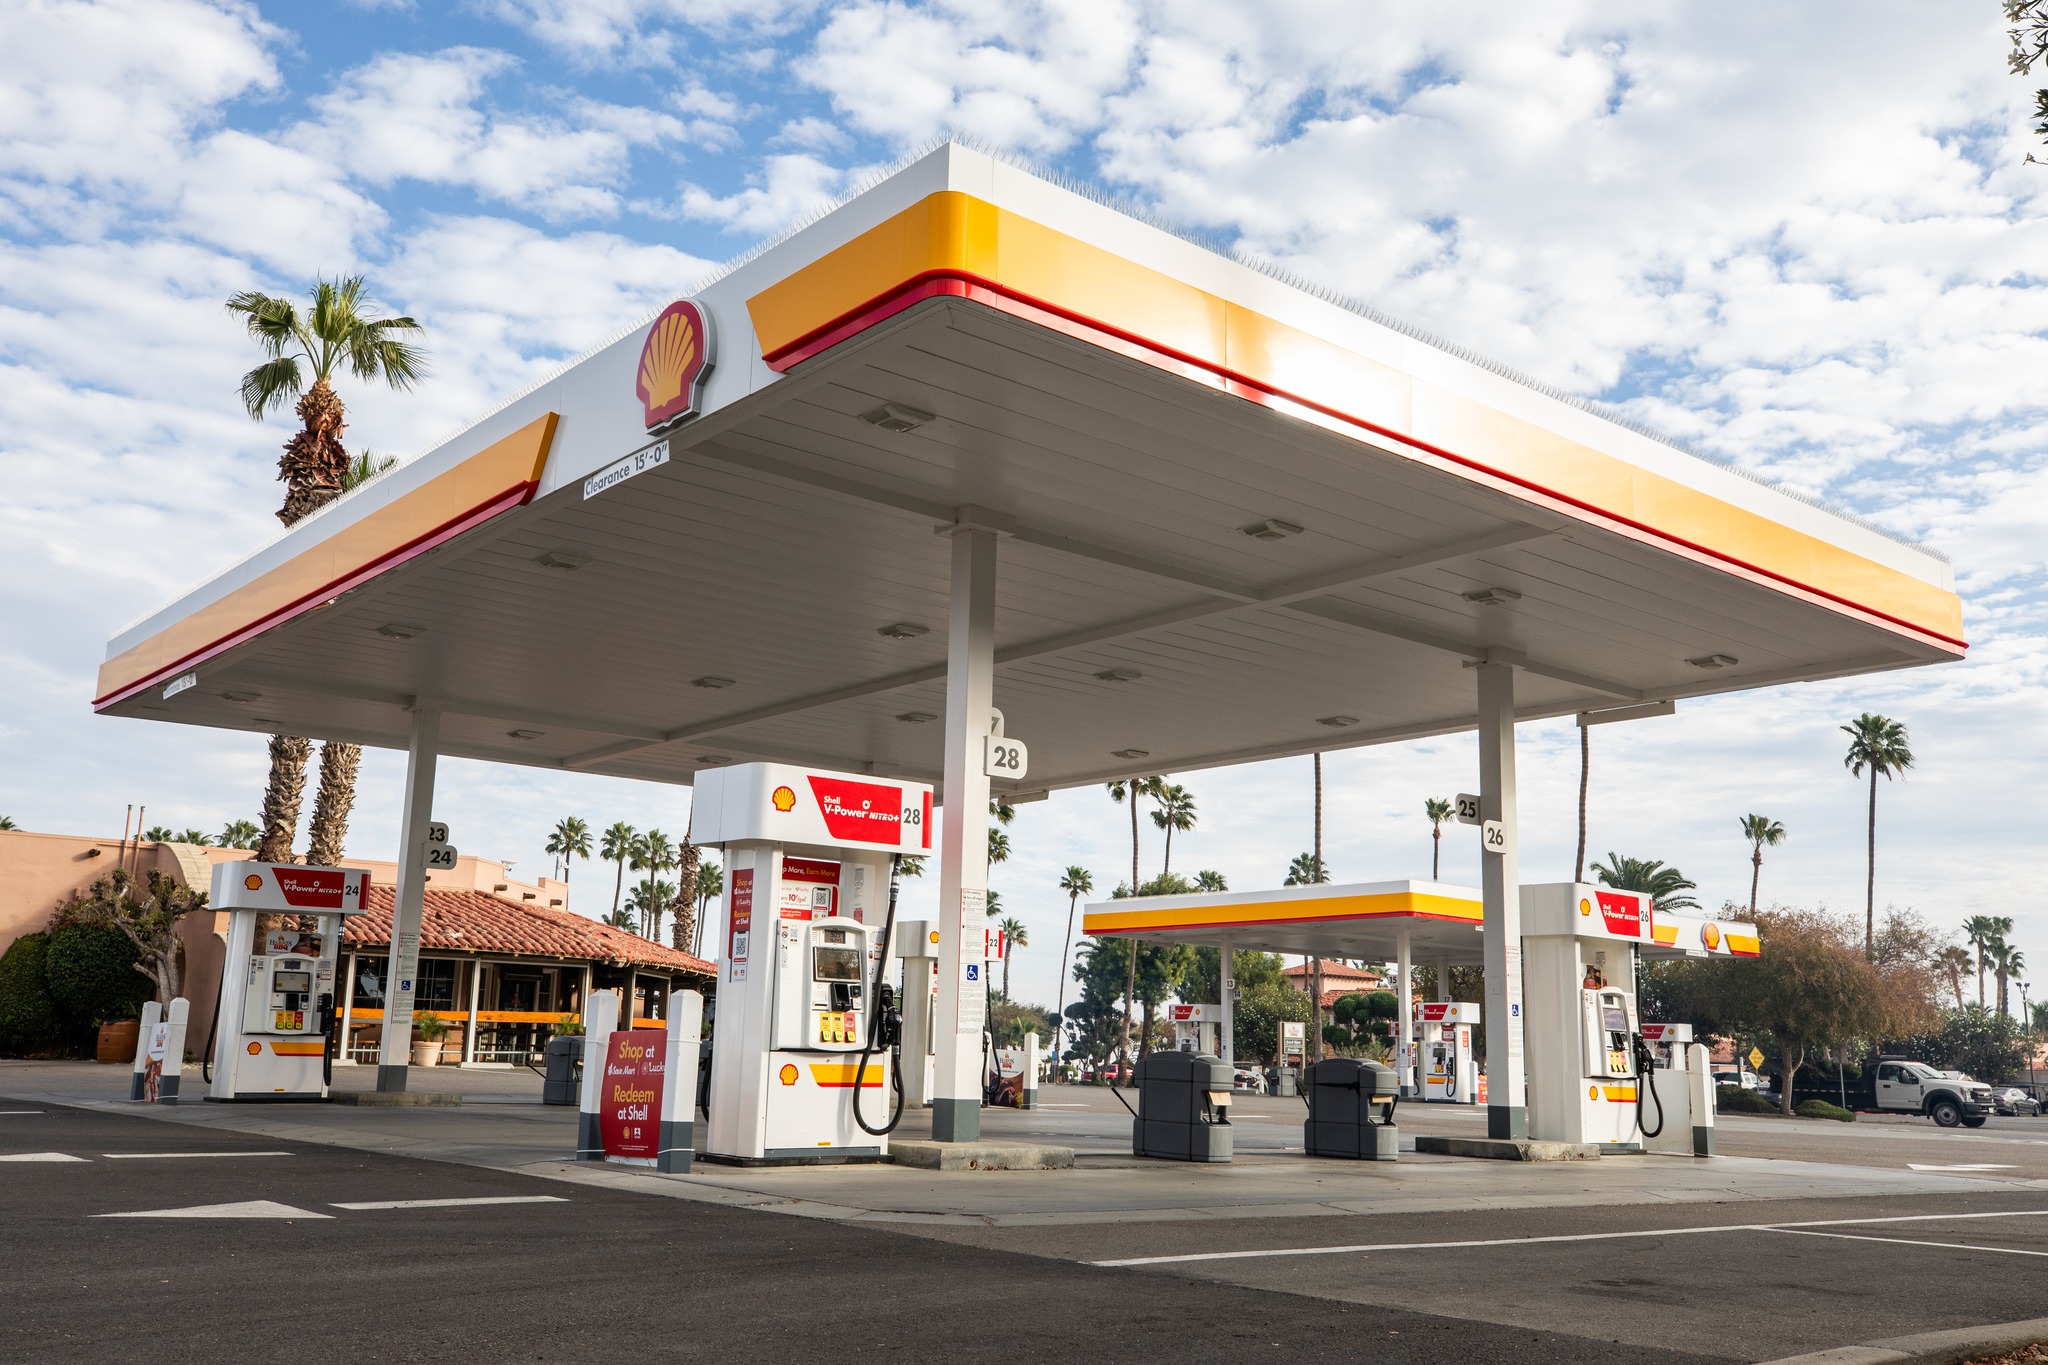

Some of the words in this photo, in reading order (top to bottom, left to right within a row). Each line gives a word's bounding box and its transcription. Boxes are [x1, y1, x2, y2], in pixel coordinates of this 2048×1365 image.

[585, 466, 630, 496] Clearance
[994, 745, 1020, 770] 28
[823, 795, 841, 805] Shell
[824, 804, 868, 818] V-Power
[1459, 800, 1476, 818] 25
[903, 808, 920, 825] 28
[429, 827, 445, 842] 23
[1487, 827, 1504, 846] 26
[430, 849, 452, 865] 24
[820, 869, 835, 877] More
[736, 879, 747, 887] Shop
[345, 885, 359, 896] 24
[734, 910, 750, 919] Redeem
[1603, 909, 1624, 919] V-Power
[1640, 911, 1649, 922] 26
[989, 939, 998, 947] 22
[1390, 976, 1397, 984] 15
[619, 1041, 644, 1063] Shop
[645, 1045, 655, 1058] at
[613, 1065, 623, 1075] Save
[623, 1065, 636, 1075] Mart
[613, 1083, 655, 1103] Redeem
[618, 1107, 626, 1120] at
[628, 1104, 648, 1121] Shell
